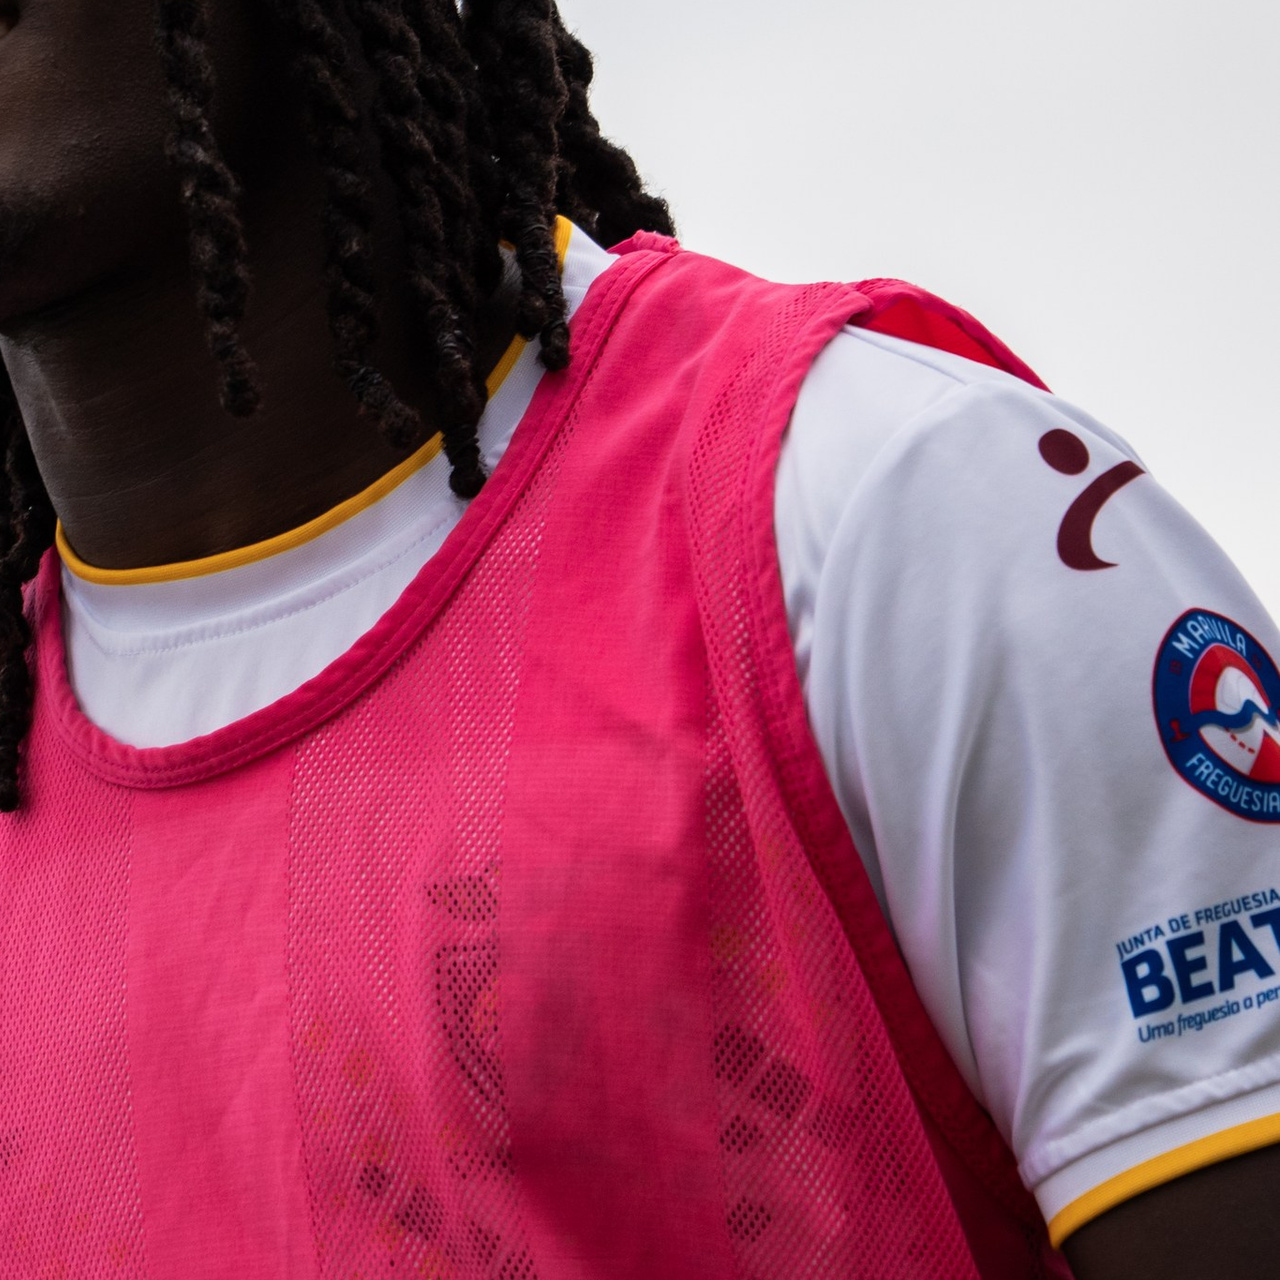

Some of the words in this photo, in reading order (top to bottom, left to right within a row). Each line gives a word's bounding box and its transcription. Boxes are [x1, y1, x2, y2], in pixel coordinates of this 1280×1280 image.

[1172, 615, 1246, 659] MARVILA
[1186, 753, 1280, 813] FREGUESIA
[1116, 924, 1166, 960] JUNTA
[1168, 914, 1193, 934] DE
[1195, 888, 1280, 926] FREGUESIA
[1138, 1022, 1176, 1043] Uma
[1177, 999, 1241, 1036] freguesia
[1243, 996, 1253, 1010] a
